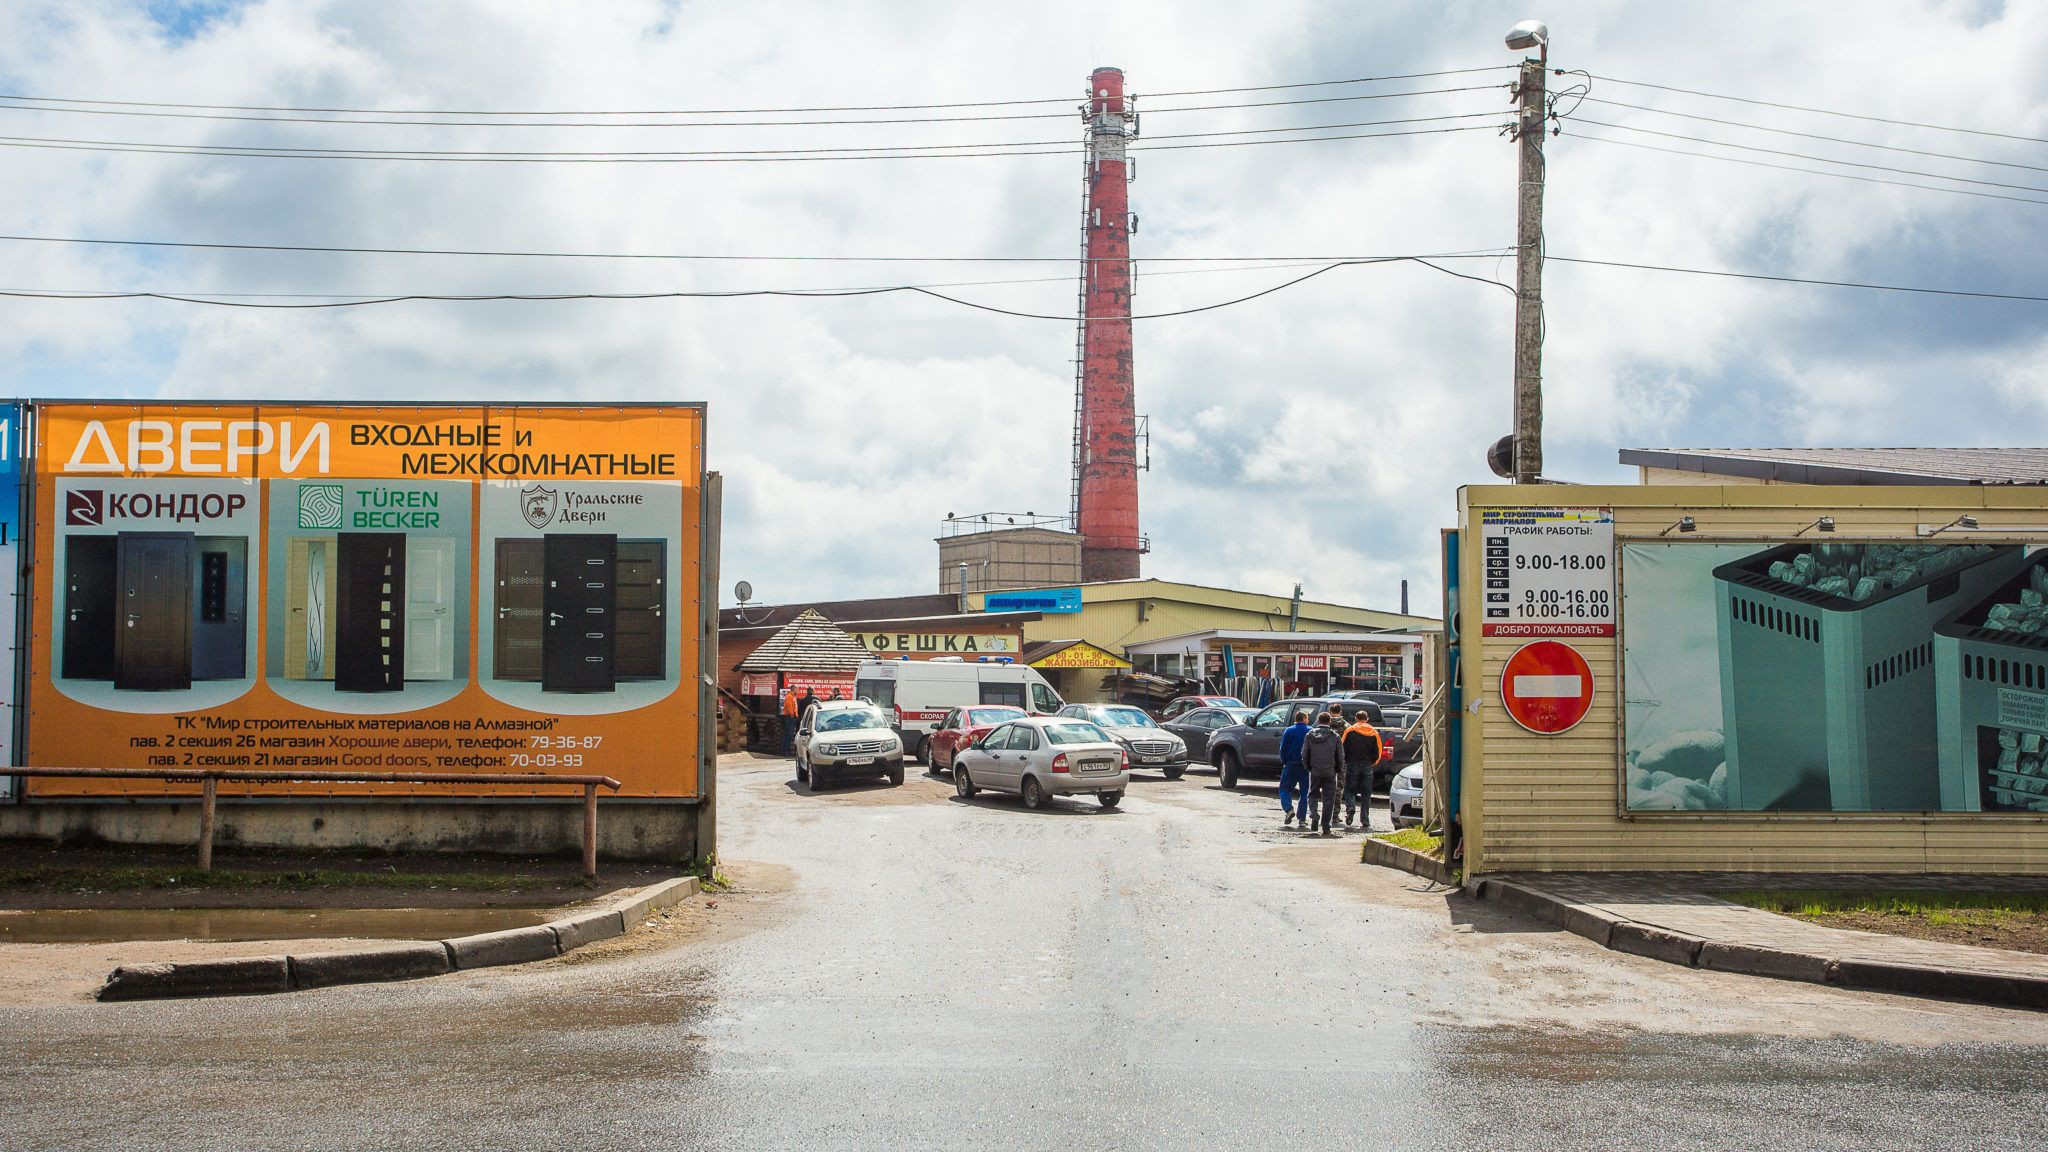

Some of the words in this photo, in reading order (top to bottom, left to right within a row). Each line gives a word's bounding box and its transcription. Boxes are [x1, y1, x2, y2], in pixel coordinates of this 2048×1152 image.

[350, 424, 501, 446] ВХОДНЫЕ
[515, 429, 532, 447] и
[64, 420, 330, 473] ДВЕРИ
[401, 453, 675, 475] МЕЖКОМНАТНЫЕ
[357, 487, 438, 507] TÜREN
[563, 491, 644, 507] Уральские
[109, 493, 246, 523] КОНДОР
[353, 512, 440, 529] BECKER
[559, 509, 606, 524] Двери
[1503, 526, 1544, 535] ГРАФИК
[1546, 526, 1593, 536] РАБОТЫ:
[1492, 559, 1504, 567] ср.
[1515, 555, 1606, 570] 9.00-18.00
[1525, 590, 1609, 603] 9.00-16.00
[1516, 604, 1609, 618] 10.00-16.00
[1495, 625, 1531, 635] ДОБРО
[1533, 625, 1604, 634] ПОЖАЛОВАТЬ
[855, 633, 978, 651] АФЕШКА
[1045, 659, 1116, 667] ЖАЛЮЗИ60.РФ
[1300, 657, 1323, 668] АКЦИЯ
[2002, 692, 2046, 705] ОСТОРОЖНО!
[174, 716, 196, 729] ТК
[200, 716, 240, 732] "Мир
[243, 718, 354, 731] строительных
[358, 718, 449, 732] материалов
[453, 720, 471, 730] на
[474, 717, 559, 731] Алмазной"
[130, 735, 161, 748] пав.
[165, 735, 176, 748] 2
[178, 736, 232, 749] секция
[236, 735, 256, 748] 26
[260, 738, 325, 748] магазин
[328, 735, 400, 750] Хорошие
[402, 737, 452, 750] двери,
[456, 735, 527, 750] телефон:
[530, 735, 603, 749] 79-36-87
[148, 754, 179, 766] пав.
[183, 753, 193, 766] 2
[196, 755, 250, 767] секция
[254, 753, 269, 766] 21
[273, 756, 338, 767] магазин
[342, 754, 381, 766] Good
[386, 753, 431, 767] doors,
[436, 754, 506, 769] телефон:
[509, 754, 583, 767] 70-03-93
